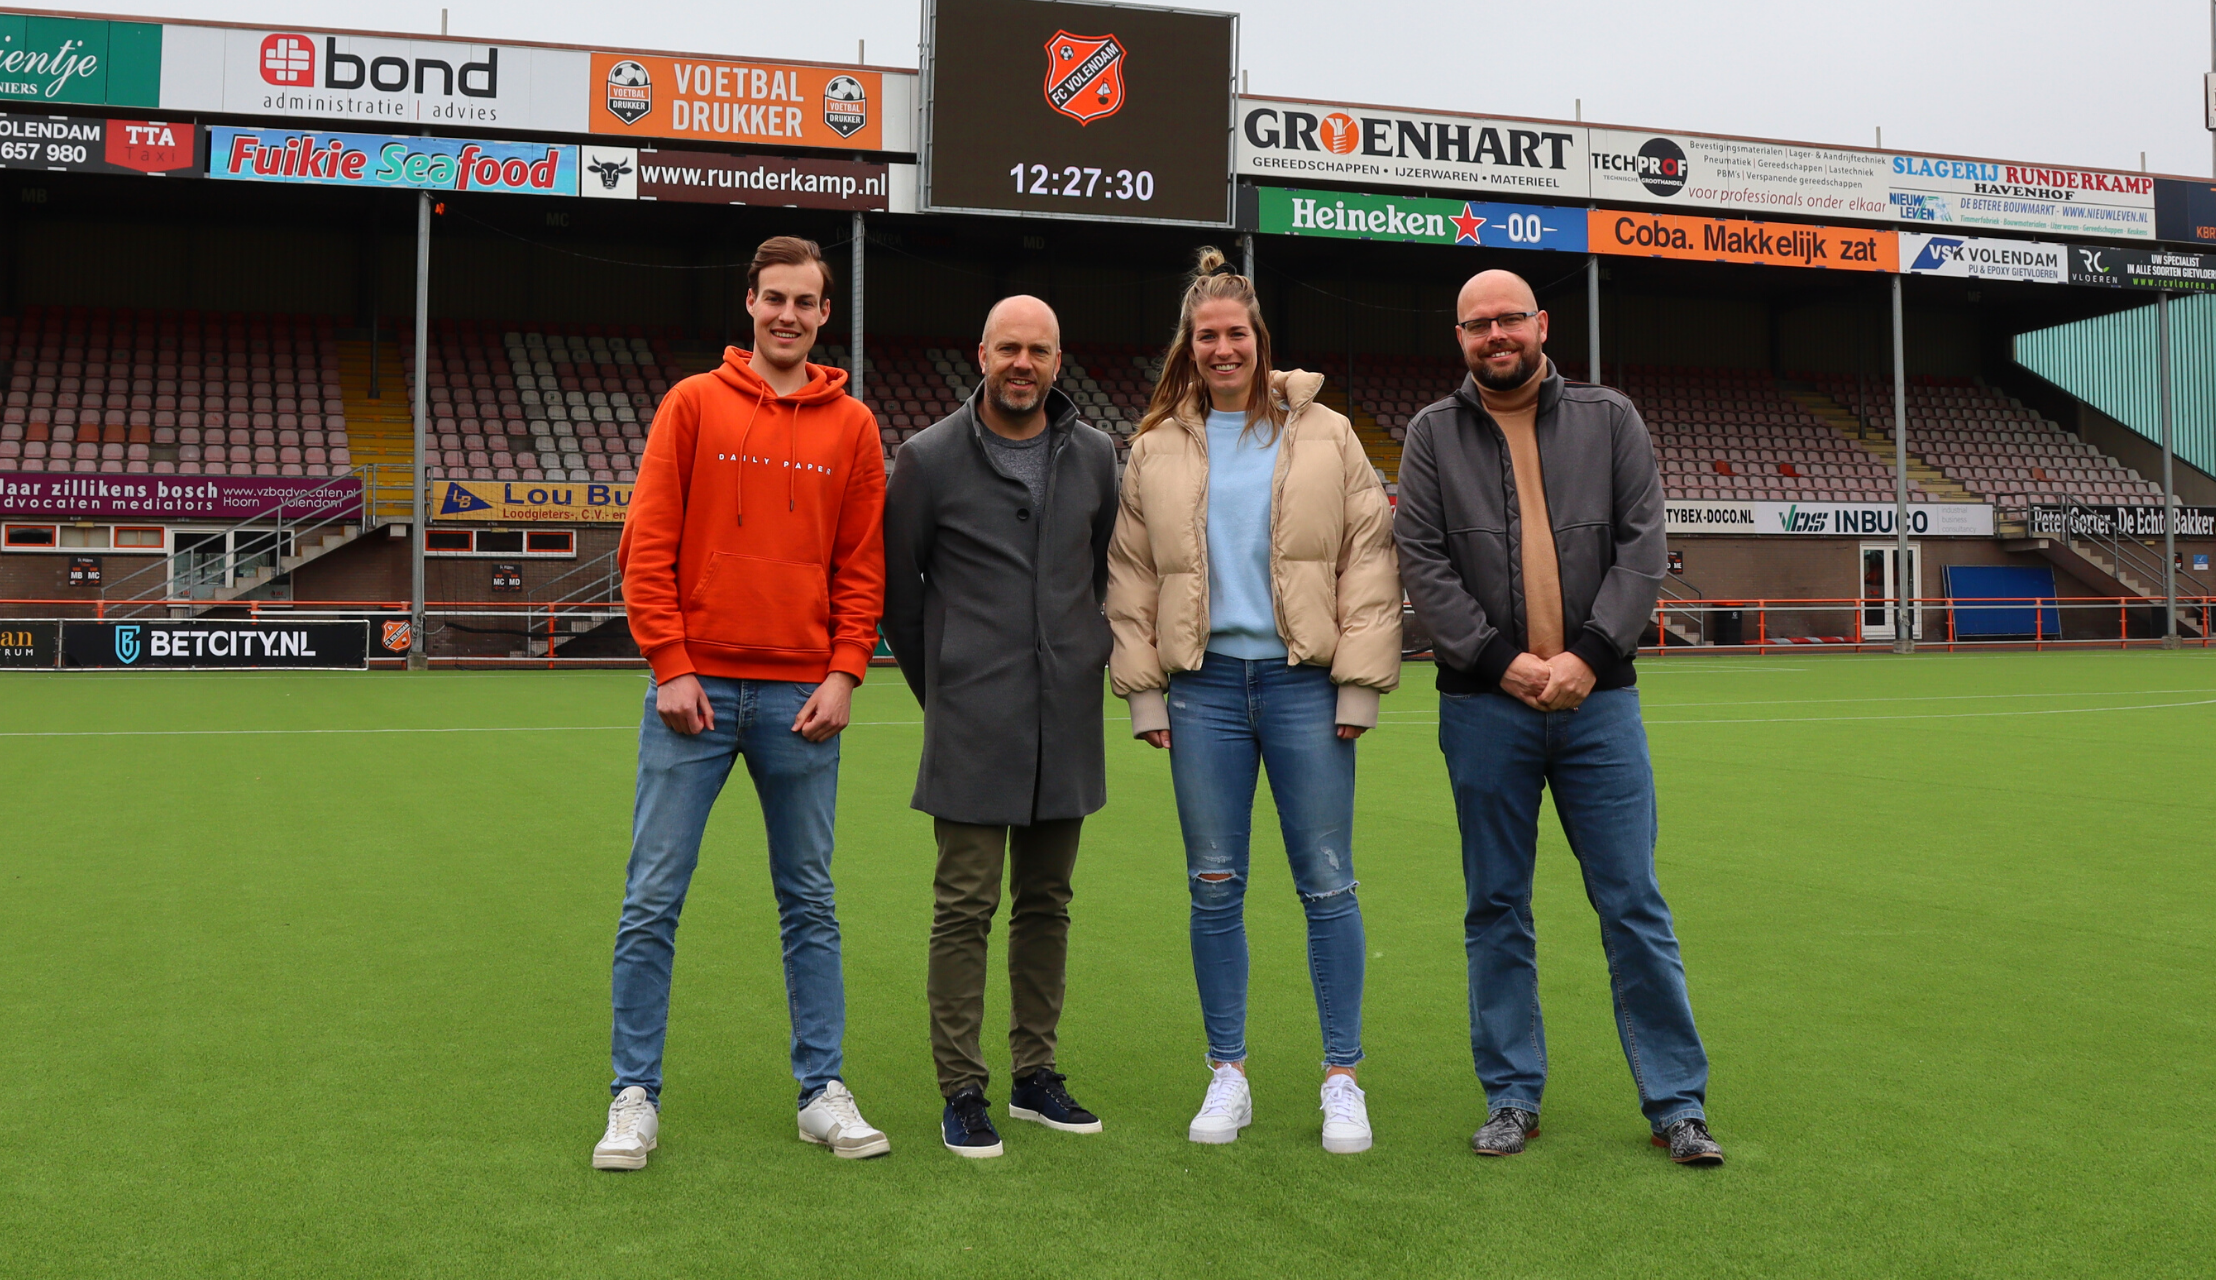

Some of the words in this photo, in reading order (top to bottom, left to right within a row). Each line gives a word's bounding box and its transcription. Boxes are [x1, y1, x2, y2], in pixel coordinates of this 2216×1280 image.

[325, 36, 498, 98] bond
[1052, 88, 1068, 105] FC
[1065, 42, 1119, 92] VOLENDAM
[674, 63, 804, 102] VOETBAL
[613, 87, 645, 99] VOETBAL
[263, 92, 404, 116] administratie
[433, 102, 497, 121] advies
[613, 100, 646, 111] DRUKKER
[829, 102, 861, 113] VOETBAL
[672, 100, 803, 137] DRUKKER
[829, 113, 861, 125] DRUKKER
[0, 120, 100, 141] OLENDAM
[125, 125, 175, 147] TTA
[1, 142, 40, 160] 657
[46, 144, 87, 163] 980
[124, 146, 175, 163] Taxi
[229, 135, 367, 180] Fuikie
[376, 141, 560, 190] Seafood
[1689, 140, 1783, 156] Bevestigingsmaterialen
[1789, 149, 1814, 160] Lager-
[1815, 151, 1822, 159] &
[1823, 151, 1886, 166] Aandrijftechniek
[1252, 156, 1380, 176] GEREEDSCHAPPEN
[1395, 166, 1479, 183] IJZERWAREN
[1490, 174, 1560, 188] MATERIEEL
[1591, 152, 1687, 177] TECHPROF
[1704, 155, 1752, 167] Pneumatiek
[1757, 160, 1823, 173] Gereedschappen
[1829, 165, 1874, 177] Lastechniek
[640, 164, 887, 199] www.runderkamp.nl
[1010, 162, 1154, 201] 12:27:30
[1603, 174, 1638, 183] TECHNISCHE
[1641, 177, 1683, 187] GROOTHANDEL
[1746, 171, 1798, 184] Verspanende
[1799, 176, 1863, 189] gereedschappen
[1892, 156, 1999, 182] SLAGERIJ
[2005, 165, 2153, 195] RUNDERKAMP
[1688, 186, 1718, 200] voor
[1720, 187, 1803, 206] professionals
[1807, 194, 1844, 209] onder
[1849, 198, 1887, 213] elkaar
[1889, 192, 1925, 207] NIEUW
[1974, 182, 2075, 201] HAVENHOF
[1291, 197, 1446, 237] Heineken
[1900, 206, 1935, 221] LEVEN
[1960, 197, 1969, 209] DE
[1973, 198, 2002, 212] BETERE
[2004, 200, 2055, 216] BOUWMARKT
[2063, 206, 2148, 223] WWW.NIEUWLEVEN.NL
[1615, 217, 1694, 250] Coba.
[1704, 224, 1828, 265] Makkelijk
[1840, 237, 1877, 262] zat
[2197, 226, 2216, 239] KBR
[1929, 244, 1965, 261] VSK
[1968, 247, 2058, 268] VOLENDAM
[2079, 249, 2110, 273] RC
[2151, 254, 2163, 265] UW
[2163, 254, 2200, 268] SPECIALIST
[1969, 264, 1978, 274] PU
[1980, 265, 1986, 274] &
[1987, 265, 2010, 276] EPOXY
[2012, 267, 2058, 279] GIETVLOEREN
[2072, 272, 2118, 284] VLOEREN
[2127, 264, 2135, 274] IN
[2136, 264, 2151, 275] ALLE
[2152, 265, 2182, 277] SOORTEN
[2182, 267, 2216, 279] GIETVLOER
[2133, 278, 2215, 290] www.rcvloeren.n
[718, 453, 770, 465] DAILY
[783, 460, 832, 475] PAPER
[51, 479, 147, 498] zillikens
[157, 481, 218, 499] bosch
[452, 489, 471, 509] LB
[504, 483, 572, 505] Lou
[3, 496, 101, 509] dvocaten
[112, 497, 214, 511] mediators
[223, 497, 260, 508] Hoorn
[1941, 506, 1967, 514] industrial
[1664, 508, 1754, 524] TYBEX-DOCO.NL
[2033, 506, 2066, 533] Peter
[2117, 507, 2135, 534] De
[2136, 507, 2166, 535] Echt
[2173, 507, 2215, 536] Bakker
[1941, 524, 1977, 534] consultancy
[71, 571, 83, 579] MB
[87, 571, 100, 580] MC
[493, 577, 505, 586] MC
[509, 578, 520, 586] MD
[0, 631, 34, 647] an
[151, 630, 316, 657] BETCITY.NL
[0, 648, 34, 656] RUM
